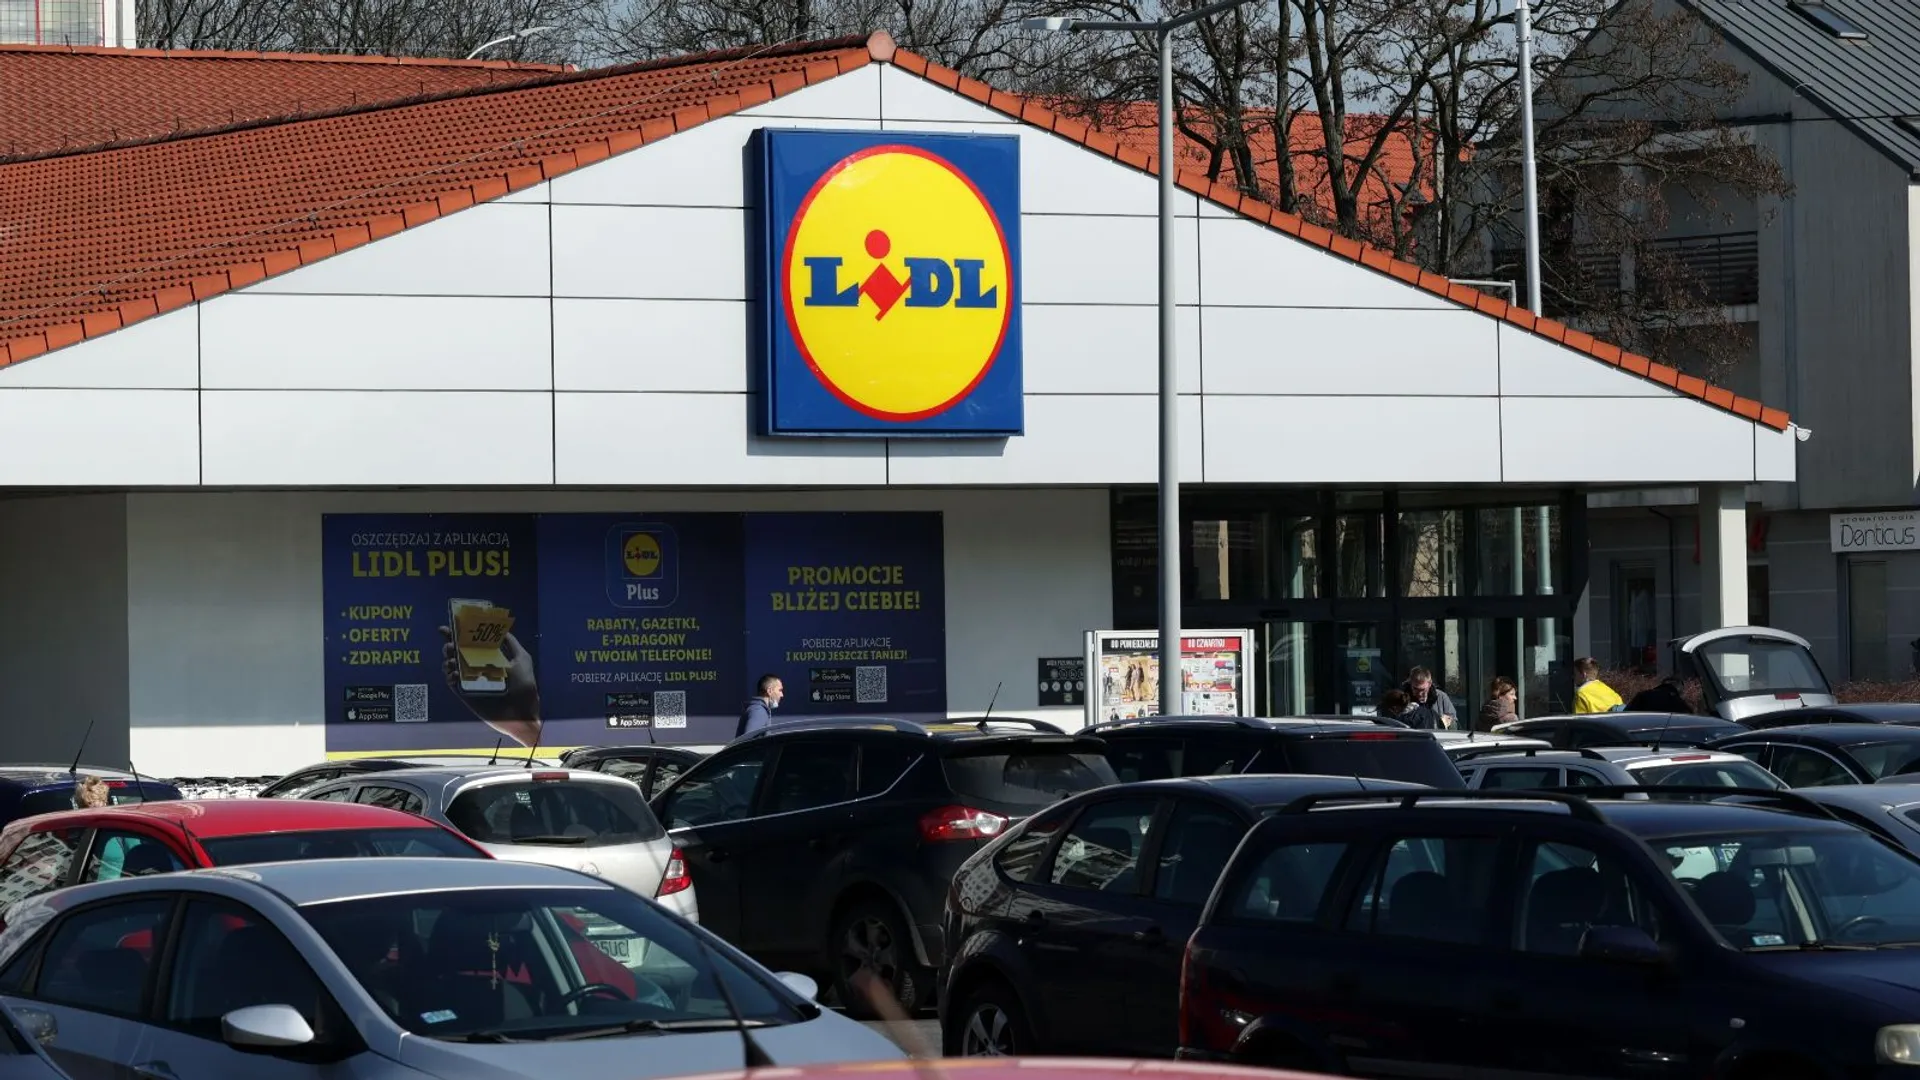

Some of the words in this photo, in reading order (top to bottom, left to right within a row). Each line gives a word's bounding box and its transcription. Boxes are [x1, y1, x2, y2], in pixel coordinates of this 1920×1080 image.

[352, 533, 430, 548] OSZCZĘDZAJ
[434, 533, 442, 545] Z
[445, 532, 510, 548] APLIKACJĄ
[1840, 523, 1915, 547] Denticus
[352, 551, 421, 577] LIDL
[428, 550, 510, 577] PLUS!
[788, 566, 904, 585] PROMOCJE
[626, 584, 660, 600] Plus
[771, 588, 841, 611] BLIŻEJ
[845, 591, 921, 610] CIEBIE!
[350, 605, 413, 620] KUPONY
[587, 618, 639, 632] RABATY,
[641, 617, 700, 631] GAZETKI,
[350, 628, 410, 642] OFERTY
[470, 622, 506, 643] -50%
[602, 634, 686, 646] E-PARAGONY
[802, 638, 842, 649] POBIERZ
[844, 637, 892, 650] APLIKACJĘ
[350, 650, 421, 665] ZDRAPKI
[575, 651, 588, 663] W
[590, 650, 638, 662] TWOIM
[641, 648, 712, 661] TELEFONIE!
[786, 652, 791, 662] I
[793, 651, 826, 661] KUPUJ
[828, 650, 868, 661] JESZCZE
[871, 649, 908, 660] TANIEJ!
[571, 673, 612, 683] POBIERZ
[613, 671, 662, 684] APLIKACJĘ
[664, 671, 688, 682] LIDL
[689, 671, 717, 681] PLUS!
